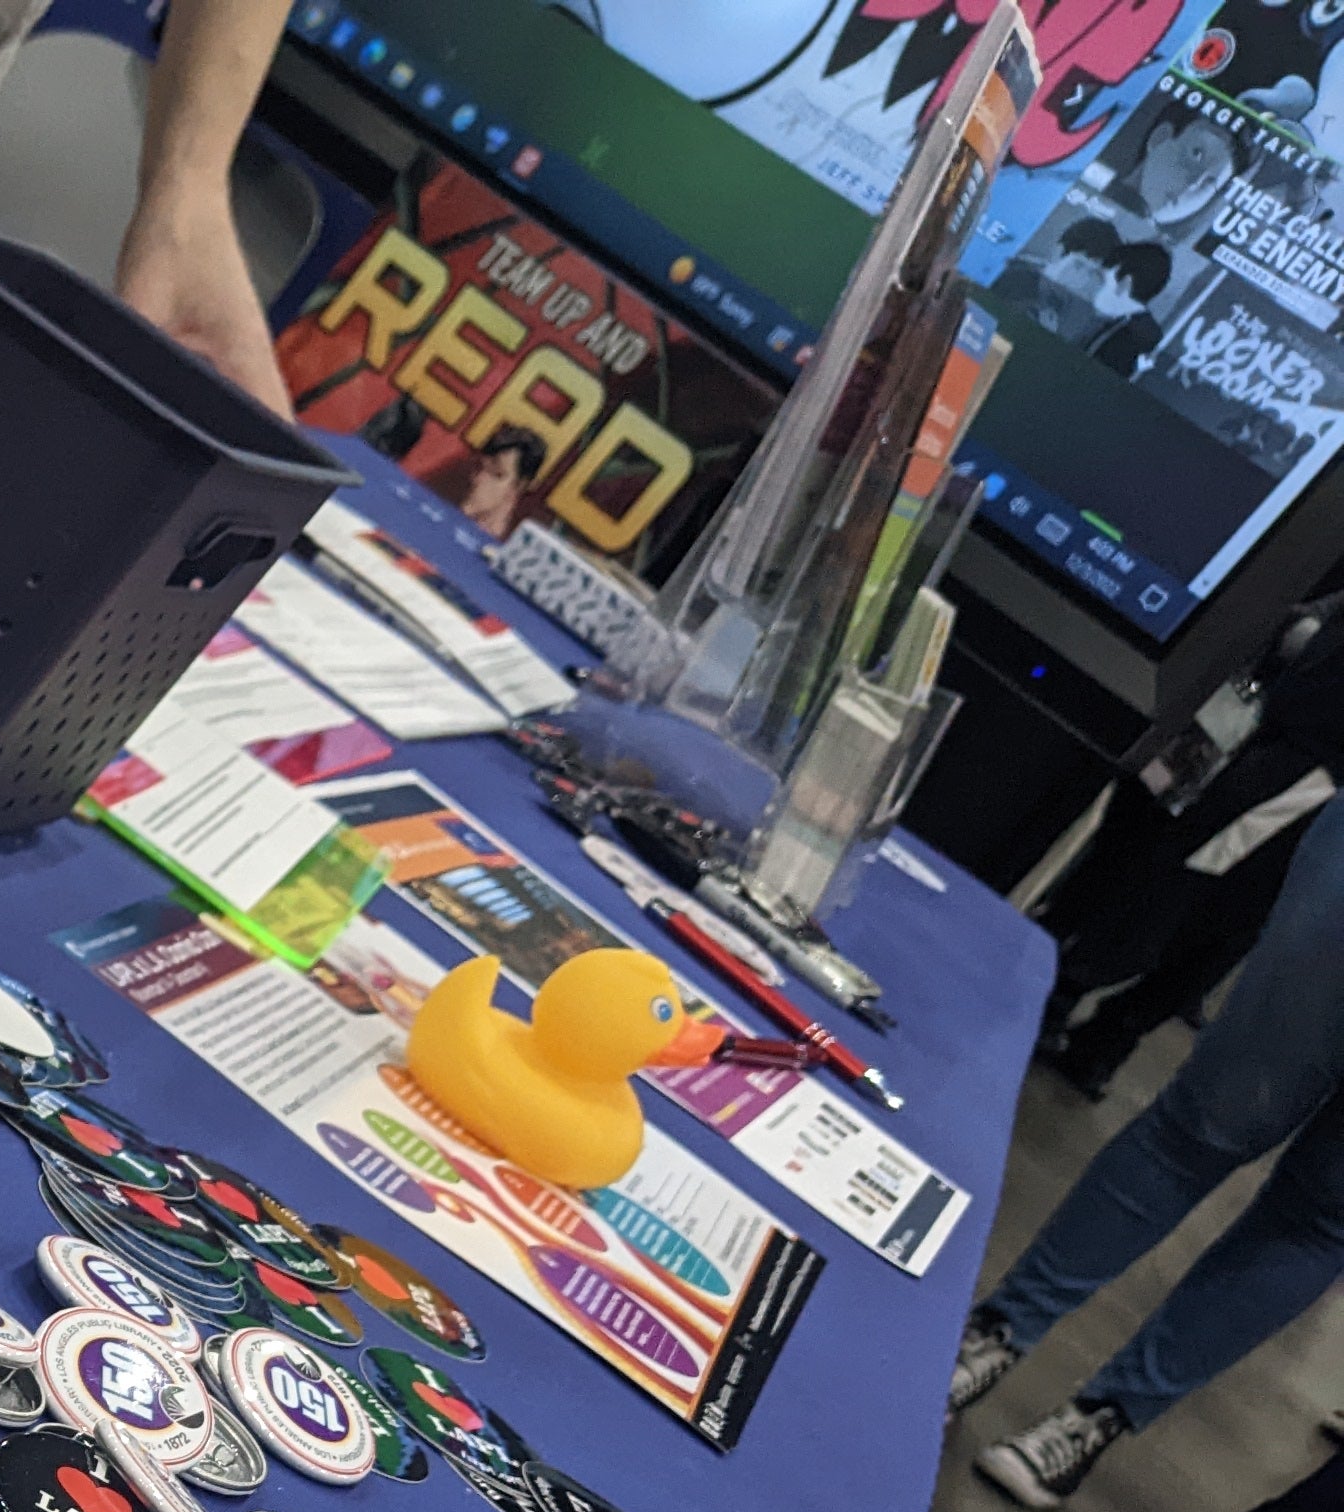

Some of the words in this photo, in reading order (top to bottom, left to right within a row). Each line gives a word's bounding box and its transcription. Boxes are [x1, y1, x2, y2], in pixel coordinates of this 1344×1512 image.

[1159, 75, 1247, 132] GEORGE
[1253, 128, 1319, 174] TAKEI
[1223, 176, 1291, 228] THEY
[1213, 206, 1250, 241] US
[1249, 226, 1344, 302] ENEMY
[477, 233, 556, 304] TEAM
[541, 281, 591, 327] UP
[577, 314, 650, 375] AND
[318, 227, 695, 554] READ
[1166, 349, 1276, 404] ROOM
[1183, 315, 1325, 402] LOCKER
[87, 1260, 170, 1324] 150
[102, 1341, 155, 1420] 150
[114, 1322, 156, 1347] LIBRARY
[161, 1353, 191, 1383] 2022
[272, 1365, 346, 1434] 150
[90, 1457, 111, 1484] I
[163, 1432, 191, 1451] 1872
